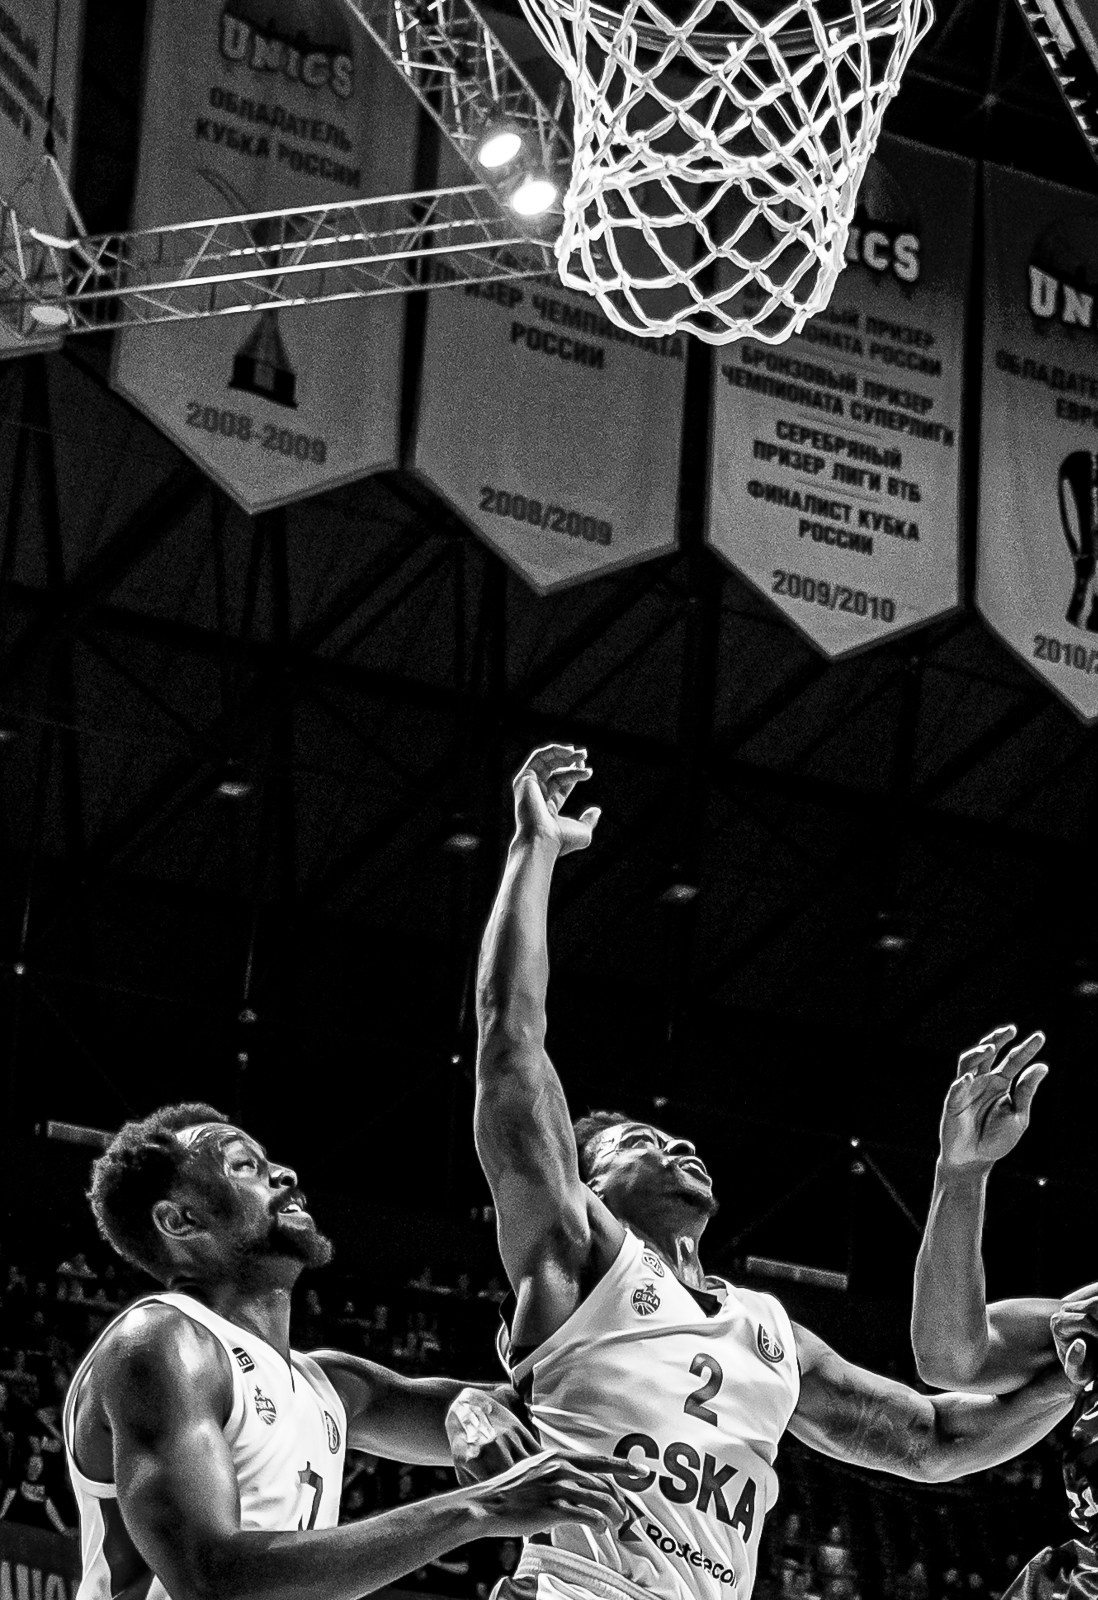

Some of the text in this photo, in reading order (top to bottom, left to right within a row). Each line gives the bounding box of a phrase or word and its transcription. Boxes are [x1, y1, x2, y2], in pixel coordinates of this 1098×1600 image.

[222, 13, 354, 97] UNICS
[196, 117, 362, 190] КУБКА РОССИИ
[510, 320, 605, 370] РОССИИ
[721, 364, 954, 448] ЧЕМПИОНАТА СУПЕРЛИГИ
[752, 439, 922, 504] ПРИЗЕР ЛИГИ ВТБ
[776, 419, 902, 471] СЕРЕБРЯНЫЙ
[479, 485, 613, 547] 2008/2009
[748, 479, 921, 542] ФИНАЛИСТ КУБКА
[799, 518, 874, 556] РОССИИ
[772, 568, 896, 624] 2009/2010
[683, 1352, 724, 1428] 2
[612, 1432, 757, 1545] CSKA
